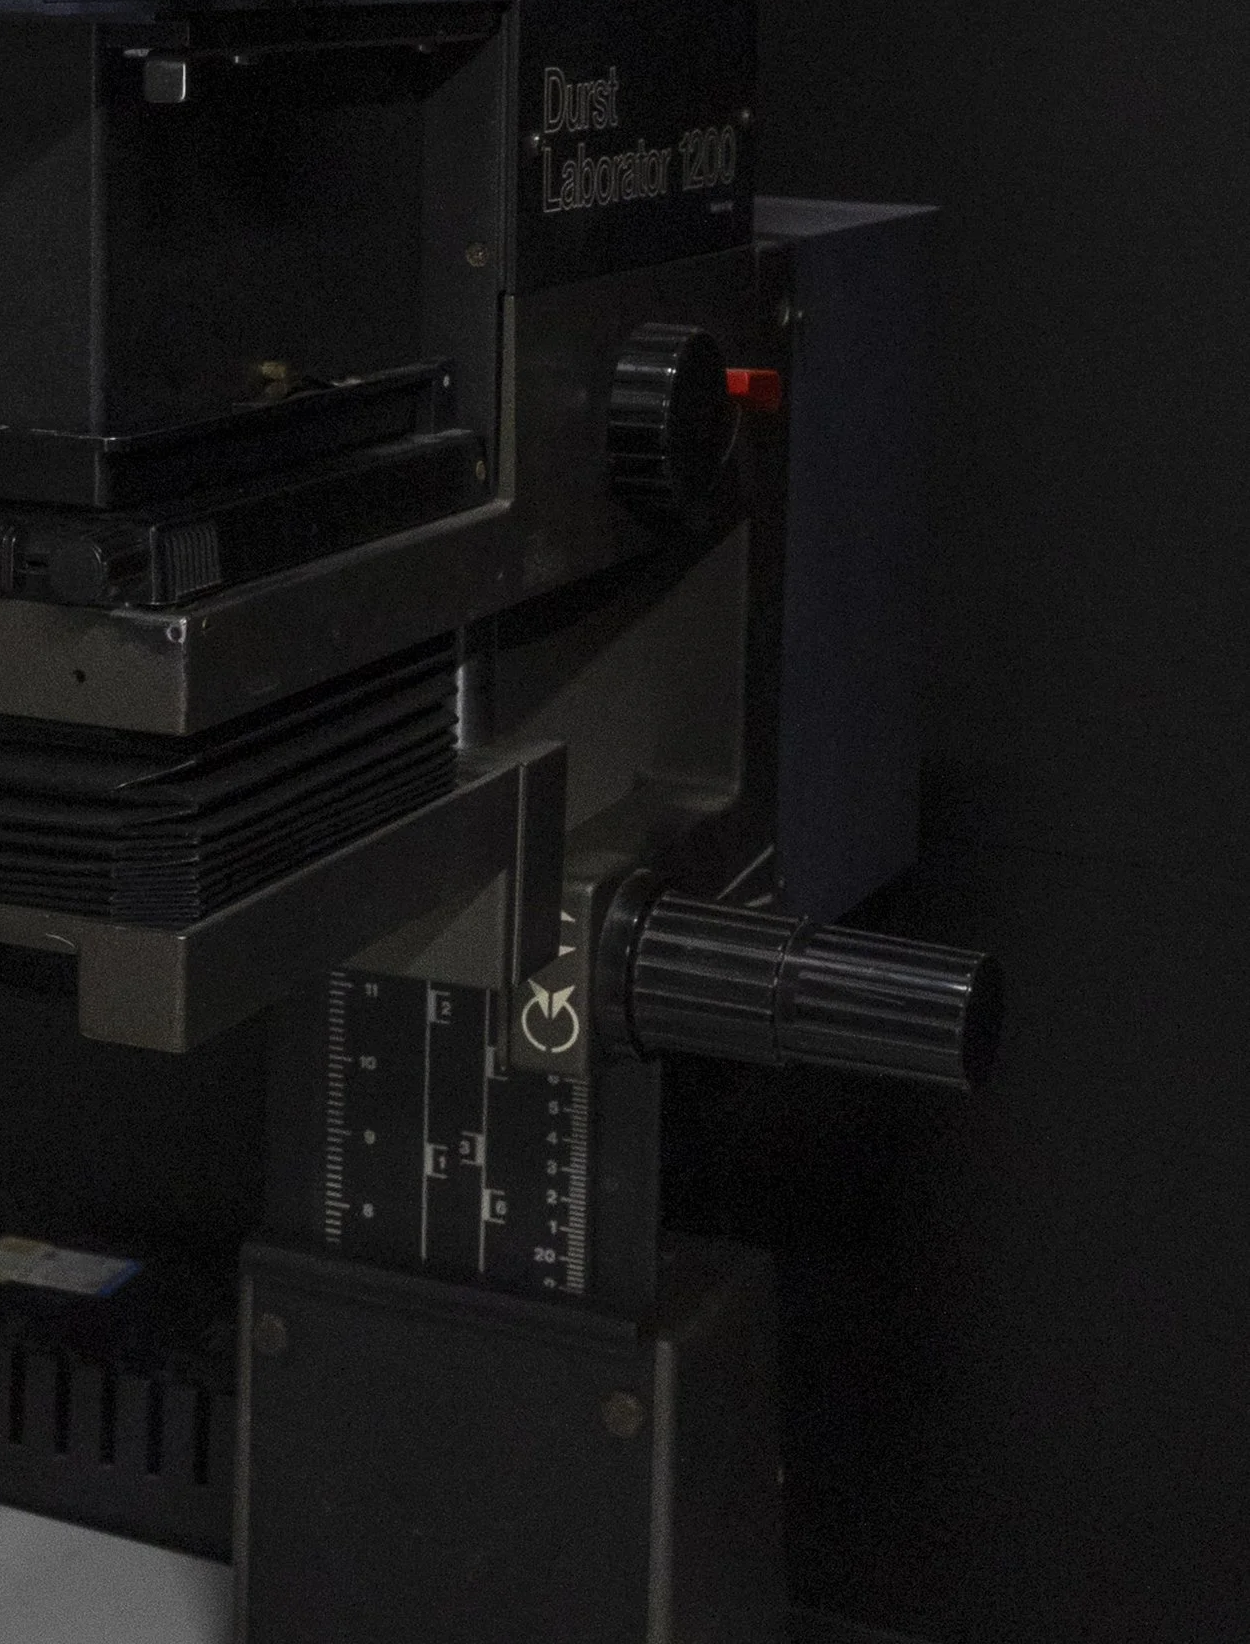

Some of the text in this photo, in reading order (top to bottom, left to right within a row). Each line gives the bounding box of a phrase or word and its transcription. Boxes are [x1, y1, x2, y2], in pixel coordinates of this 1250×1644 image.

[545, 66, 620, 133] Durst
[543, 124, 737, 213] Laborator 1200
